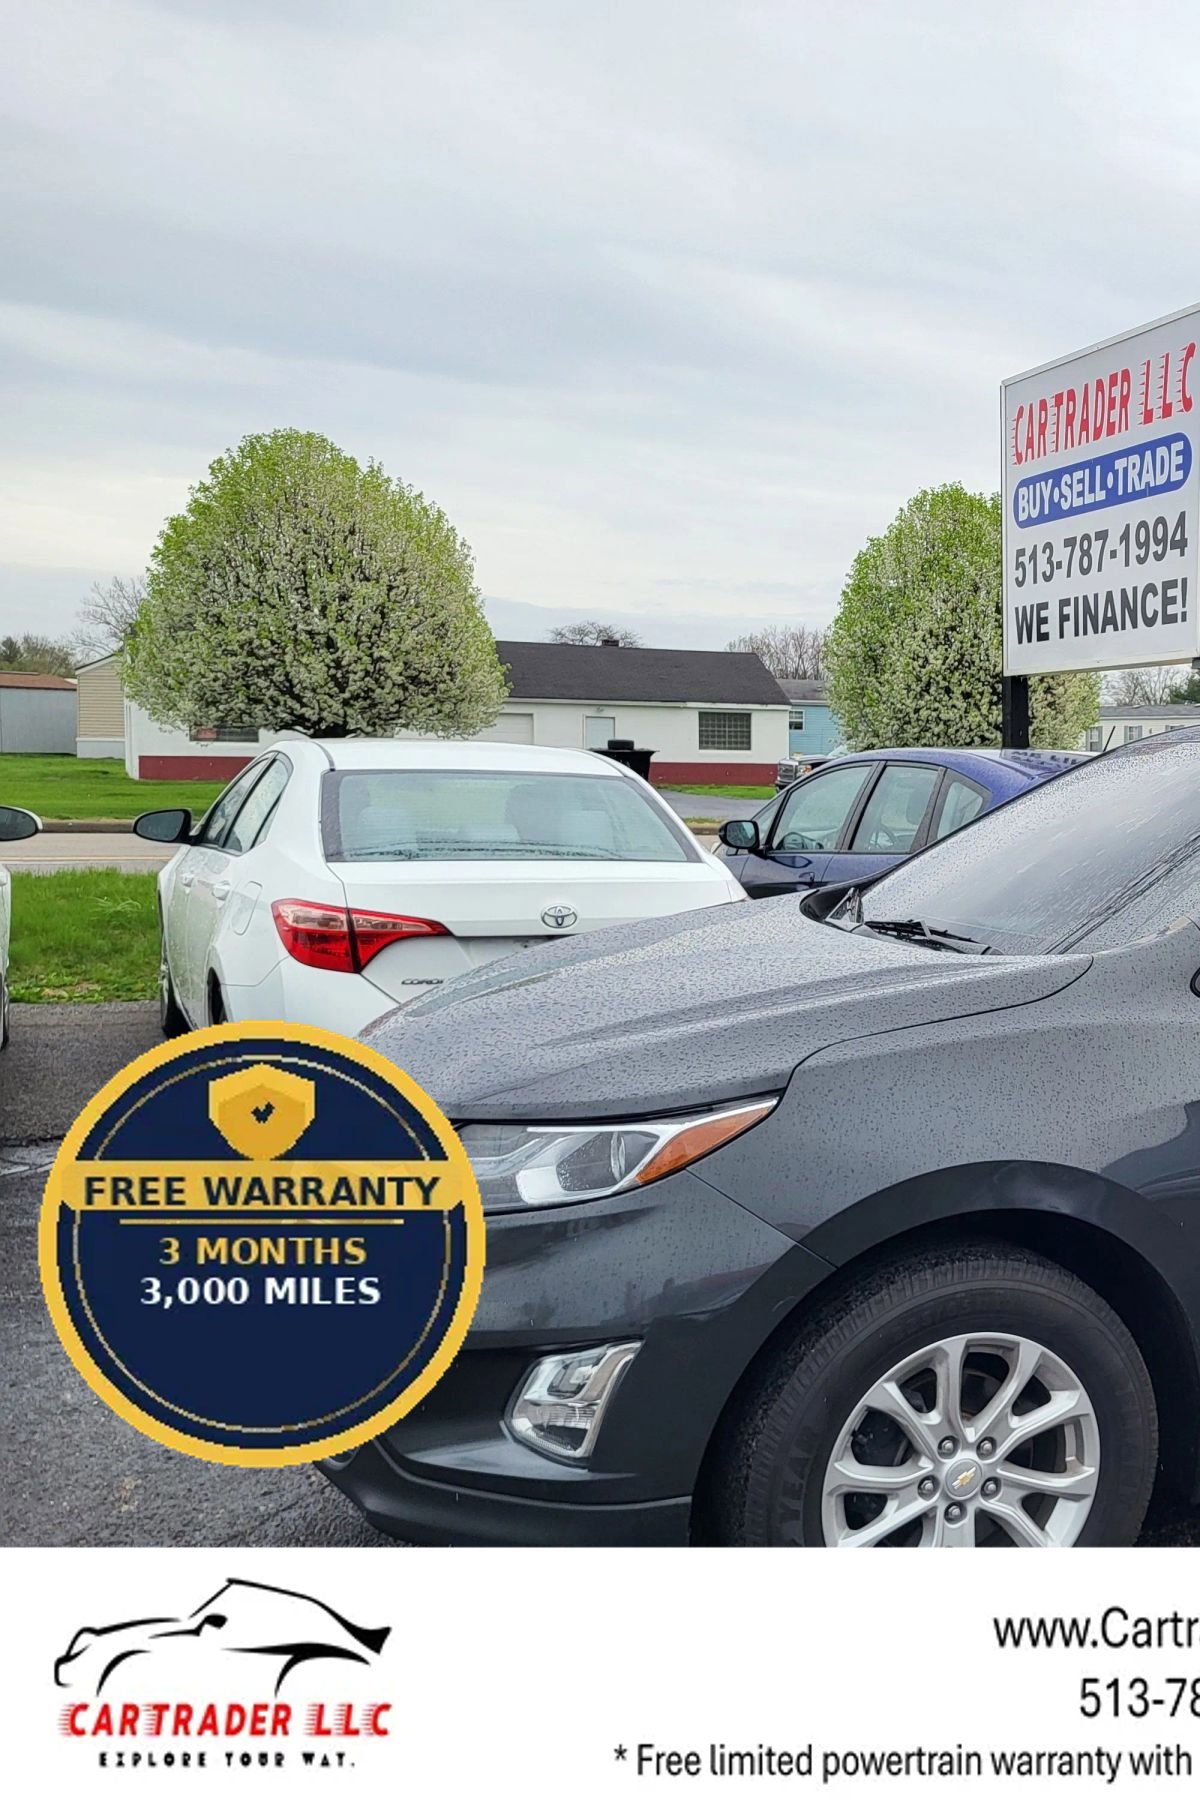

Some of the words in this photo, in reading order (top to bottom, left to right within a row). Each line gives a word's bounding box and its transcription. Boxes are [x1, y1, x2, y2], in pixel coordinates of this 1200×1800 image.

[1138, 341, 1197, 426] LLC
[1014, 510, 1189, 588] 513-787-1994
[1014, 601, 1051, 645] WE
[1058, 576, 1189, 640] FINANCE!
